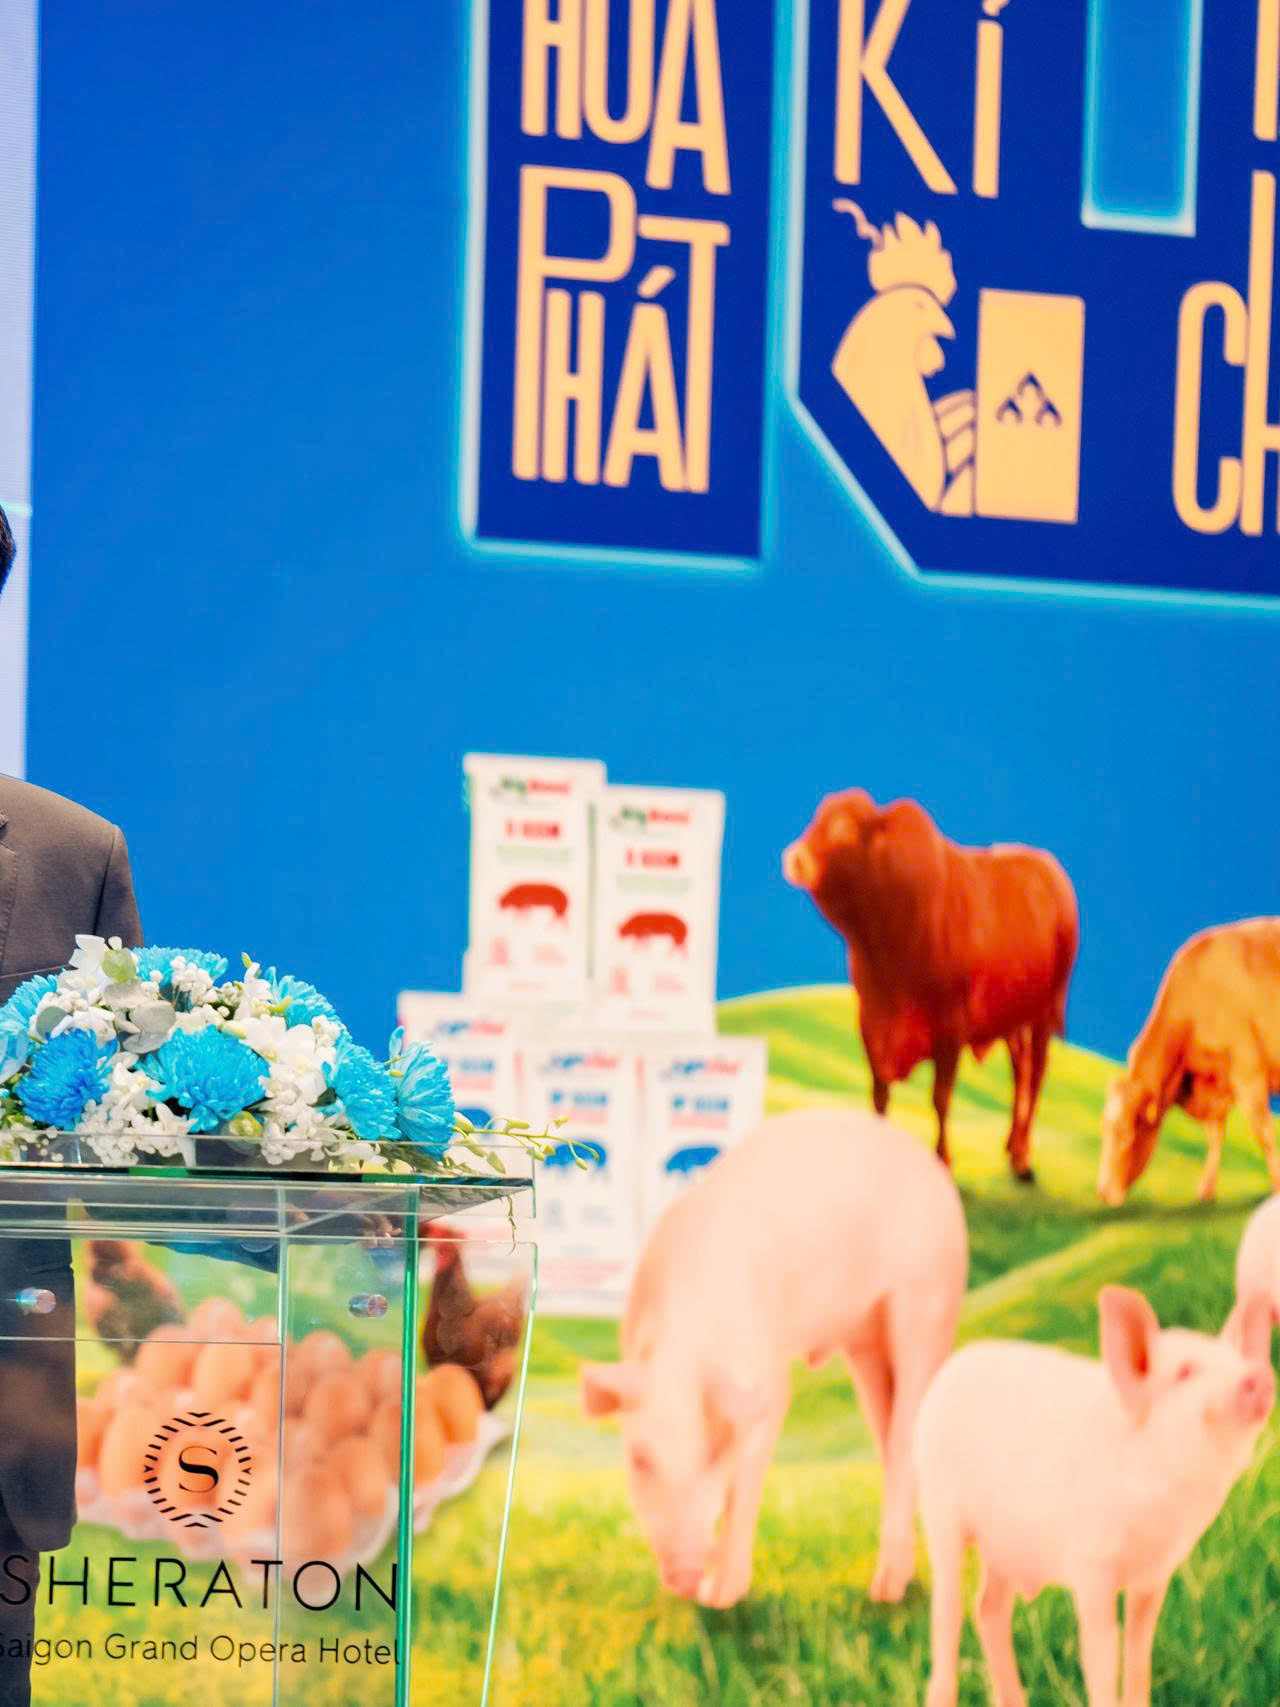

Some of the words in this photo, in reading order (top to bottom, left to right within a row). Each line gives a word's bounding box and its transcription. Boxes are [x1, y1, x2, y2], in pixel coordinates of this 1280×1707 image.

[512, 164, 732, 494] PHÁT
[0, 1554, 397, 1613] SHERATON
[104, 1633, 198, 1661] Grand
[210, 1635, 307, 1668] Opera
[319, 1637, 400, 1665] Hotel
